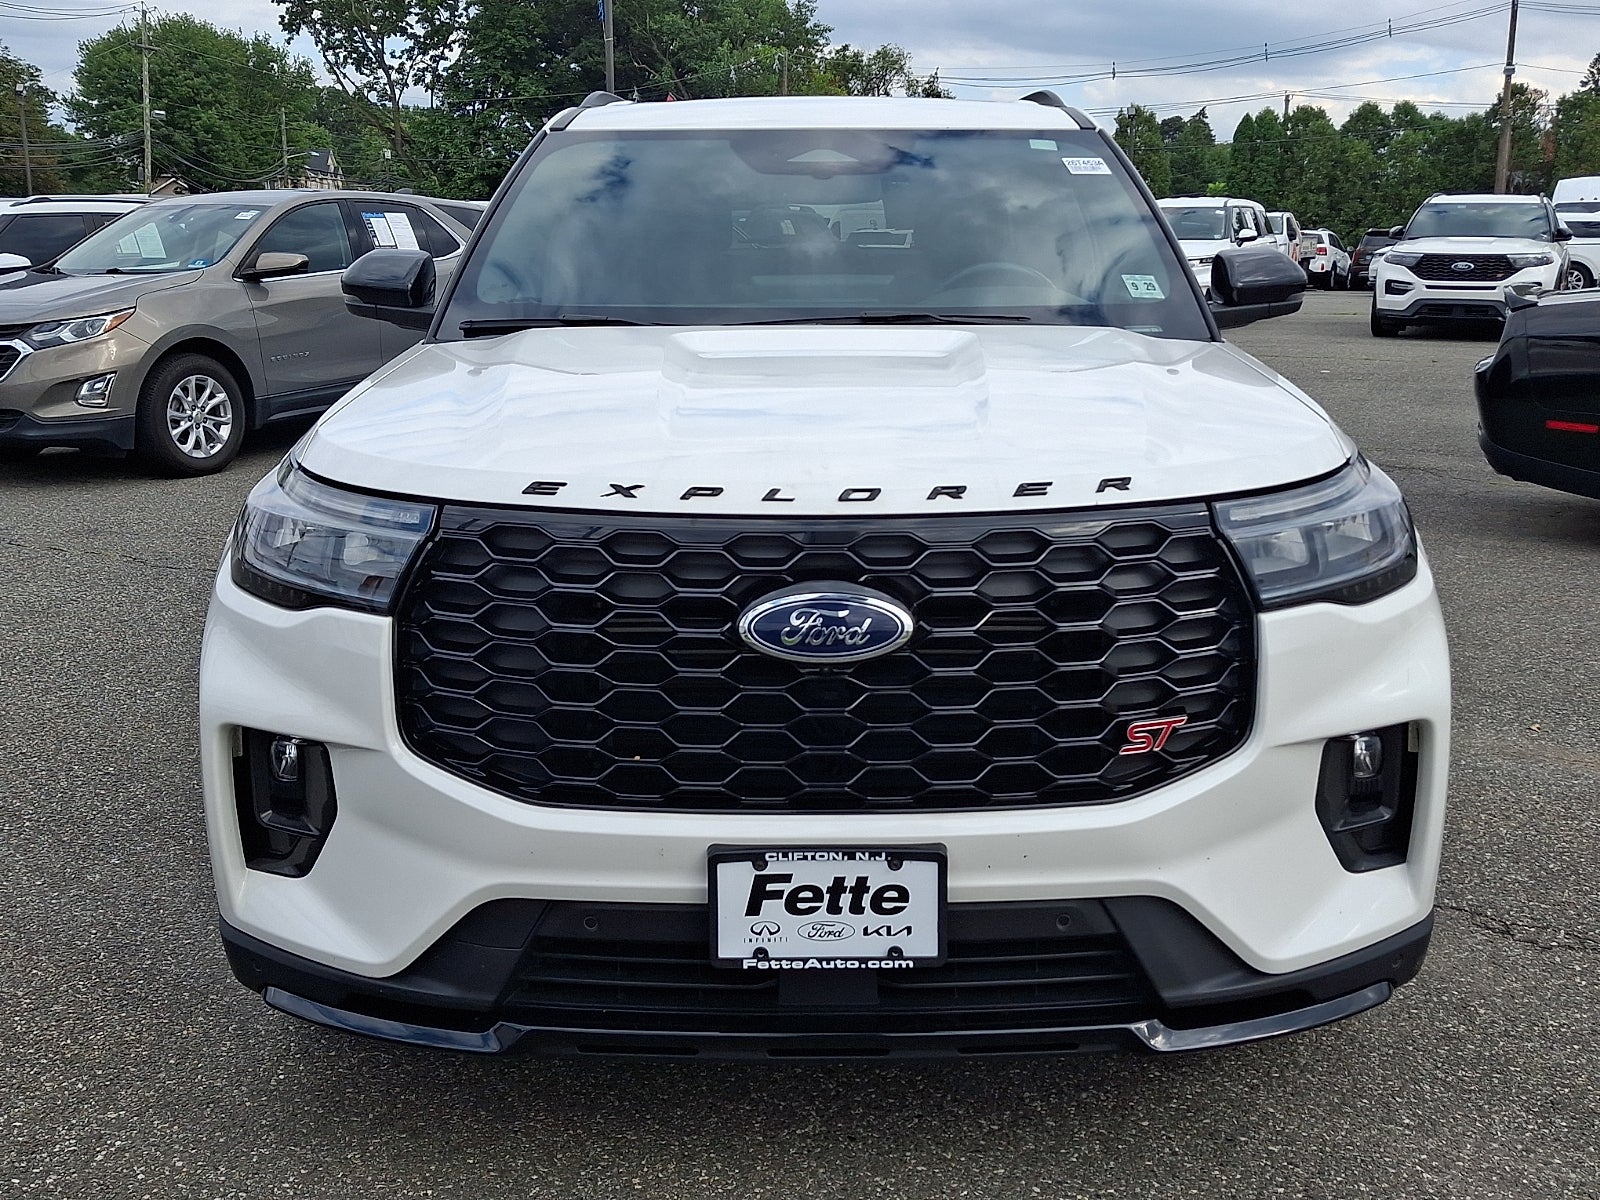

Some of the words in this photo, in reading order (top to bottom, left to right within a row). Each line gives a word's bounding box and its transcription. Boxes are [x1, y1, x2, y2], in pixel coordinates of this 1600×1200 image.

[1131, 282, 1139, 291] 9
[1143, 282, 1156, 291] 29
[521, 476, 1132, 502] EXPLORER
[780, 608, 873, 646] Ford
[1119, 715, 1188, 756] ST
[764, 852, 848, 861] CLIFTON,
[744, 873, 911, 917] Fette
[806, 923, 845, 939] Ford
[743, 959, 914, 970] FetteAuto.com
